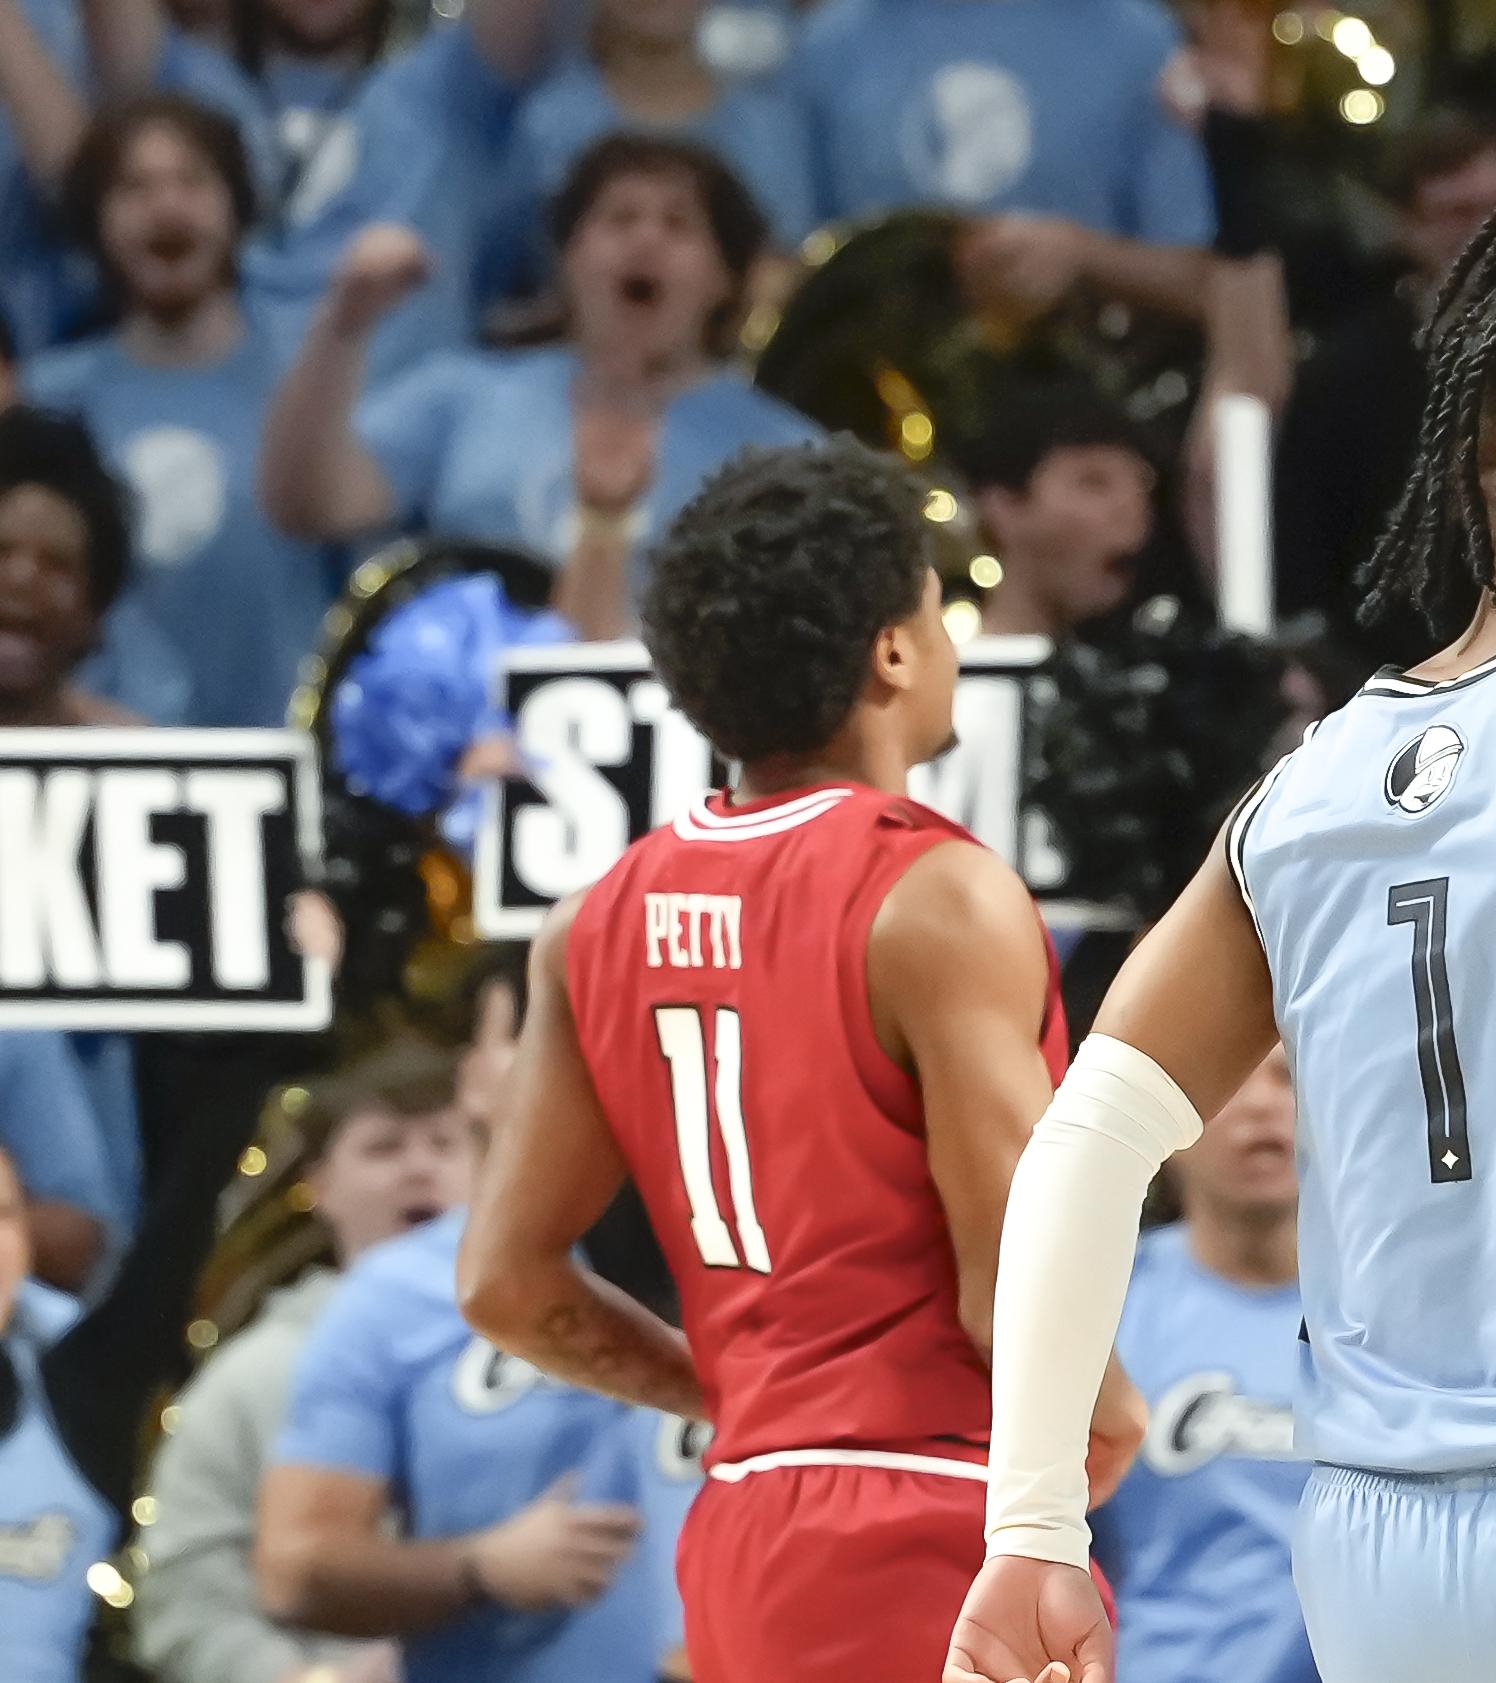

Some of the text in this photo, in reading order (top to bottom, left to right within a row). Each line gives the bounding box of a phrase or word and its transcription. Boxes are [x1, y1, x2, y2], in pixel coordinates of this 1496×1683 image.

[0, 766, 287, 991] KET
[651, 1003, 771, 1275] 11
[1387, 876, 1472, 1184] 1
